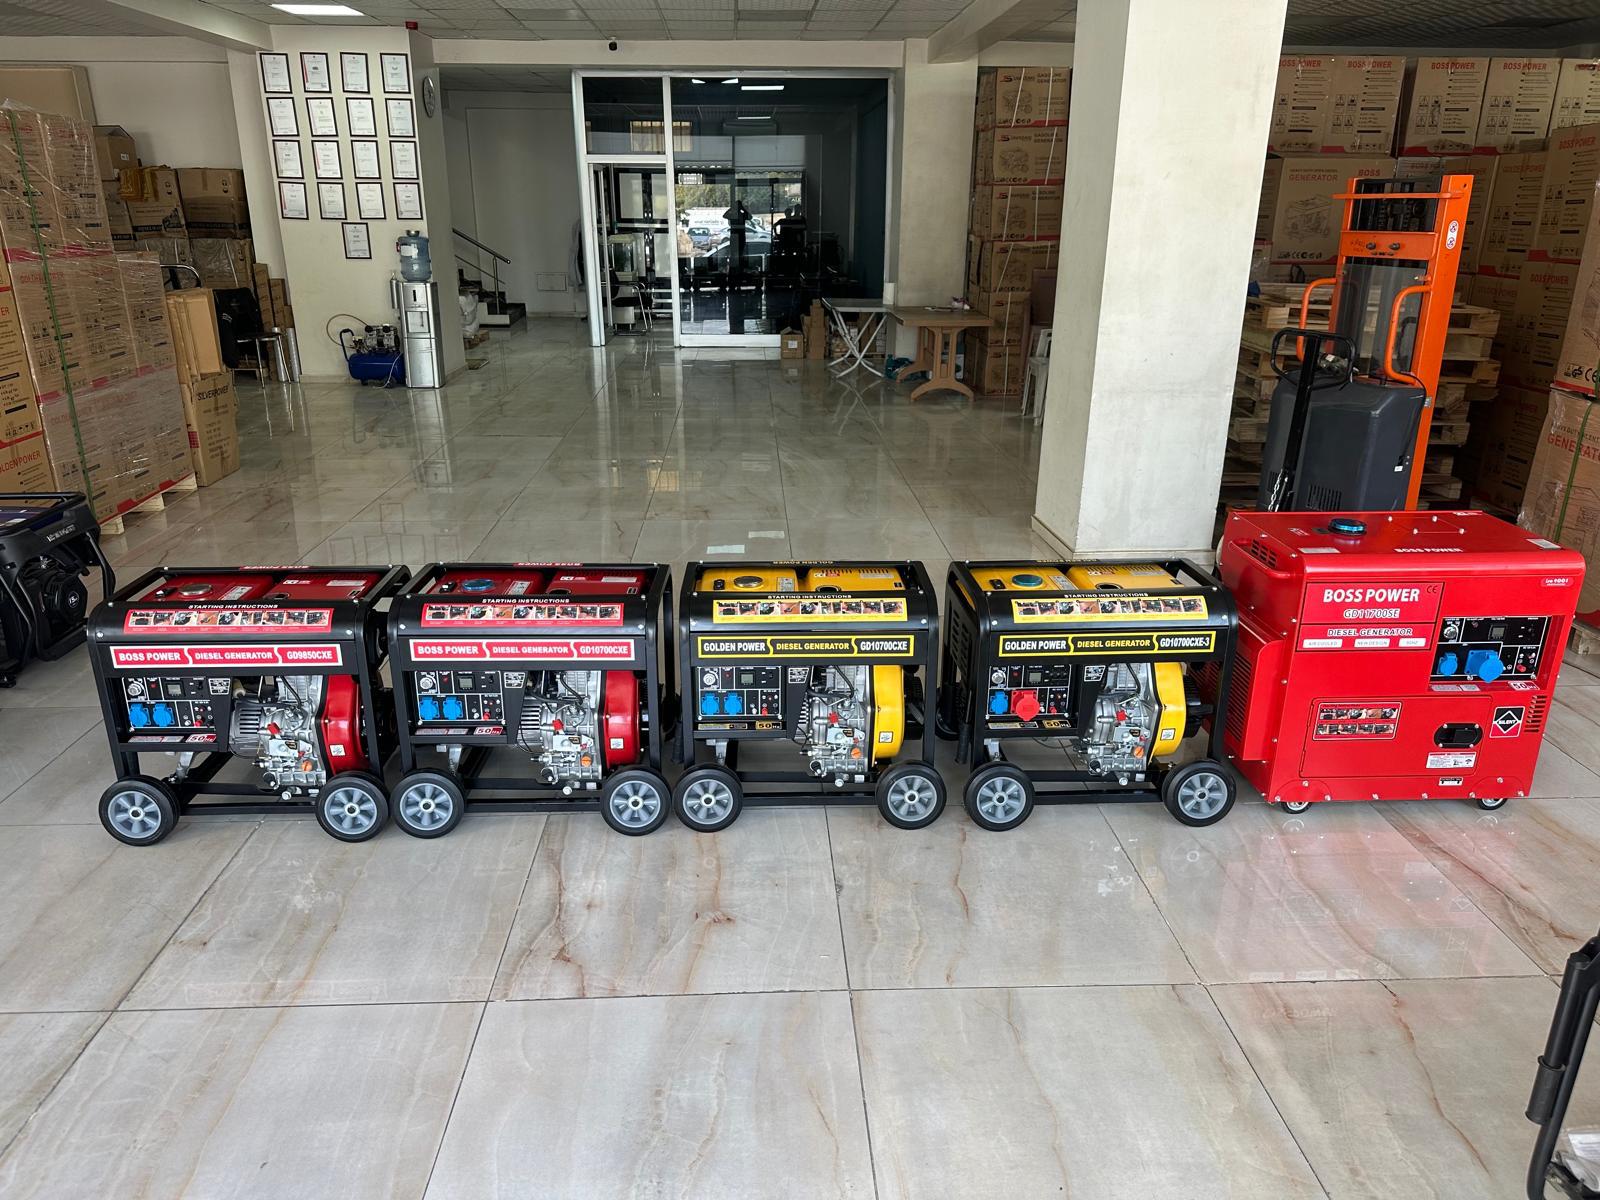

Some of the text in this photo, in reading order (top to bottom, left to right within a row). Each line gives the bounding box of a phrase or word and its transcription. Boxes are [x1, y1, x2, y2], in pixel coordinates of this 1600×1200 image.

[1431, 62, 1449, 70] BOSS
[1503, 62, 1547, 70] BOSS POWER
[1358, 168, 1381, 177] BOSS
[1288, 174, 1338, 182] GENERATOR
[20, 451, 41, 464] POWER
[1426, 585, 1438, 594] CE
[1323, 588, 1420, 602] BOSS POWER
[1343, 608, 1401, 619] GD11700SE
[1360, 628, 1412, 636] GENERATOR
[703, 642, 766, 651] GOLDEN POWER
[804, 642, 850, 650] GENERATOR
[860, 641, 908, 651] GD10700CXE
[1004, 640, 1066, 650] GOLDEN POWER
[1077, 639, 1151, 648] DIESEL GENERATOR
[1160, 637, 1210, 648] GD10700CXE-3
[417, 646, 479, 654] BOSS POWER
[492, 646, 569, 654] DIESEL GENERATOR
[579, 645, 628, 655] GD10700CXE
[118, 652, 181, 661] BOSS POWER
[194, 651, 273, 660] DIESEL GENERATOR
[286, 650, 333, 660] GD9850CXE
